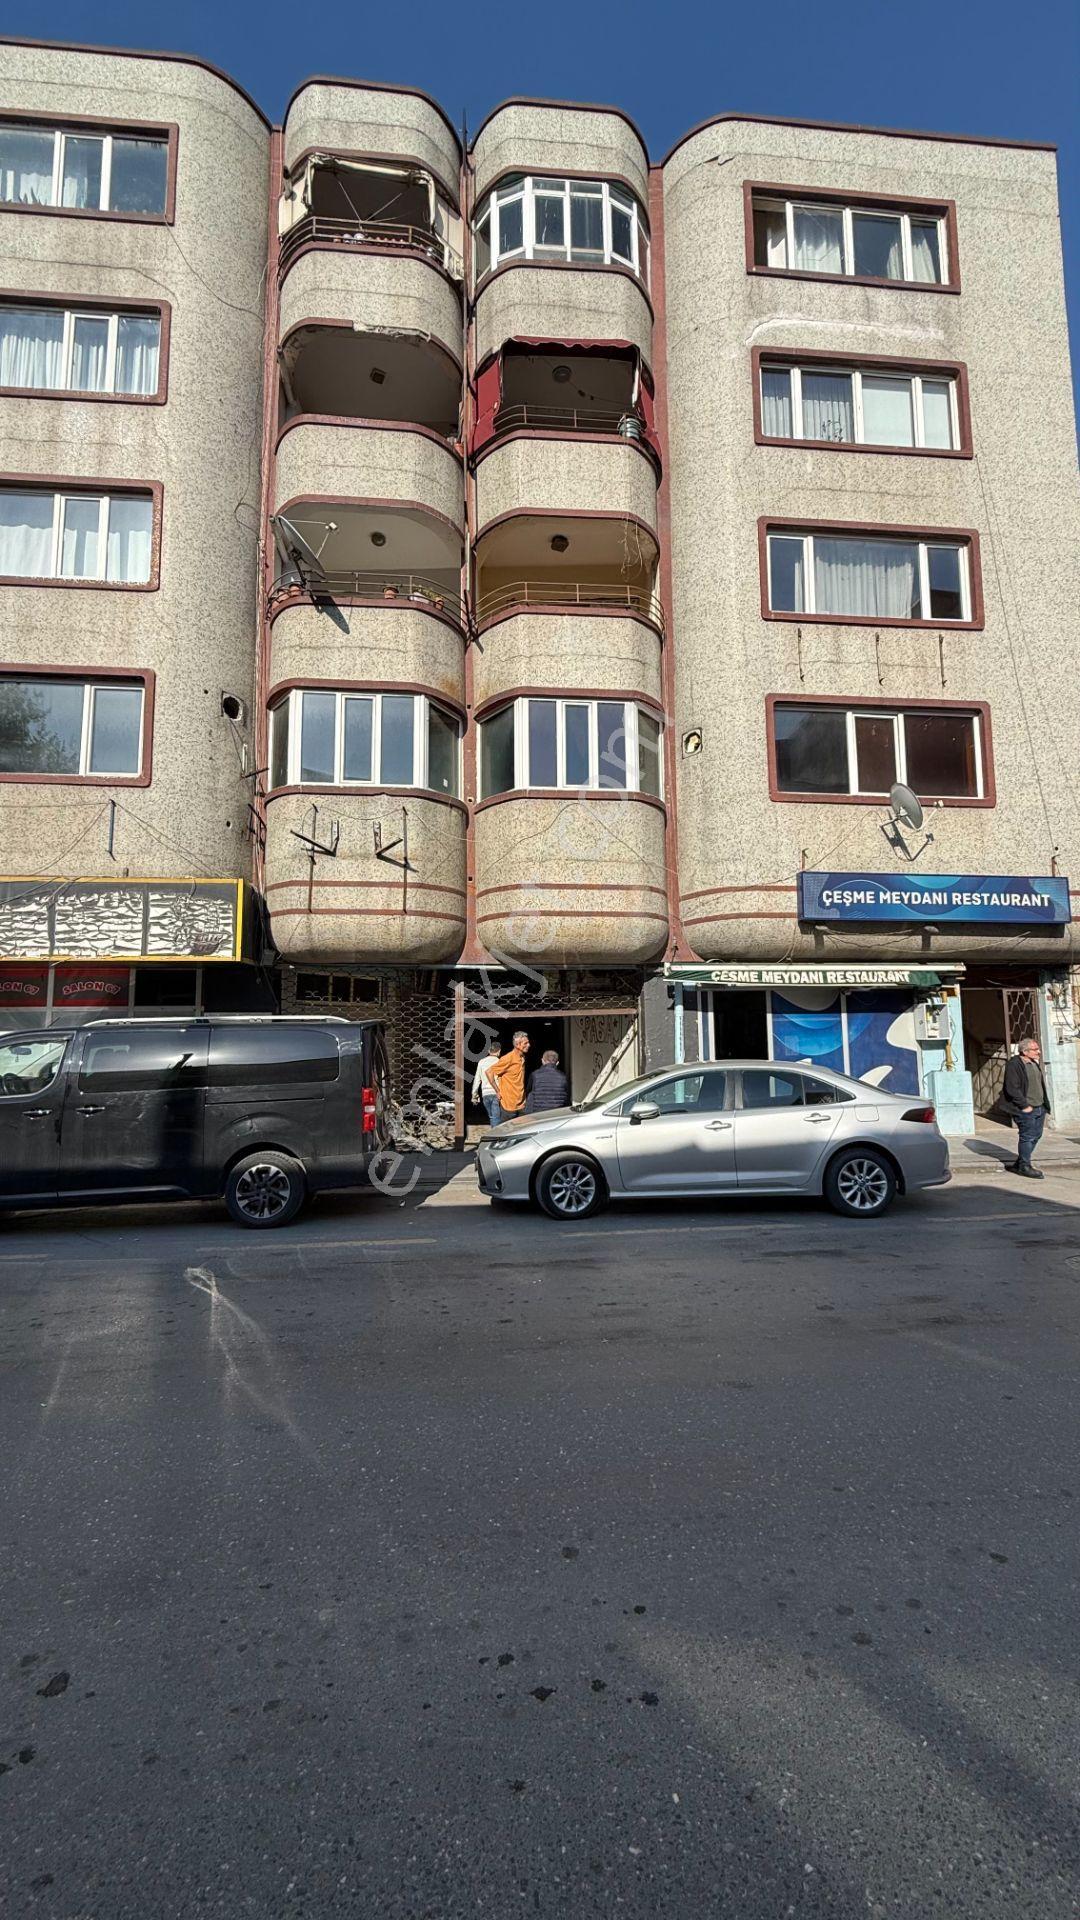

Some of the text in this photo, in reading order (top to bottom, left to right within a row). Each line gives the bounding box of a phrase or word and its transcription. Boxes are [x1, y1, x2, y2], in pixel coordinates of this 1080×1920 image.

[822, 890, 1050, 907] ÇEŞME MEYDANI RESTAURANT
[761, 970, 824, 984] MEYDANI
[826, 971, 911, 984] RESTAURANT
[62, 982, 104, 995] SALON
